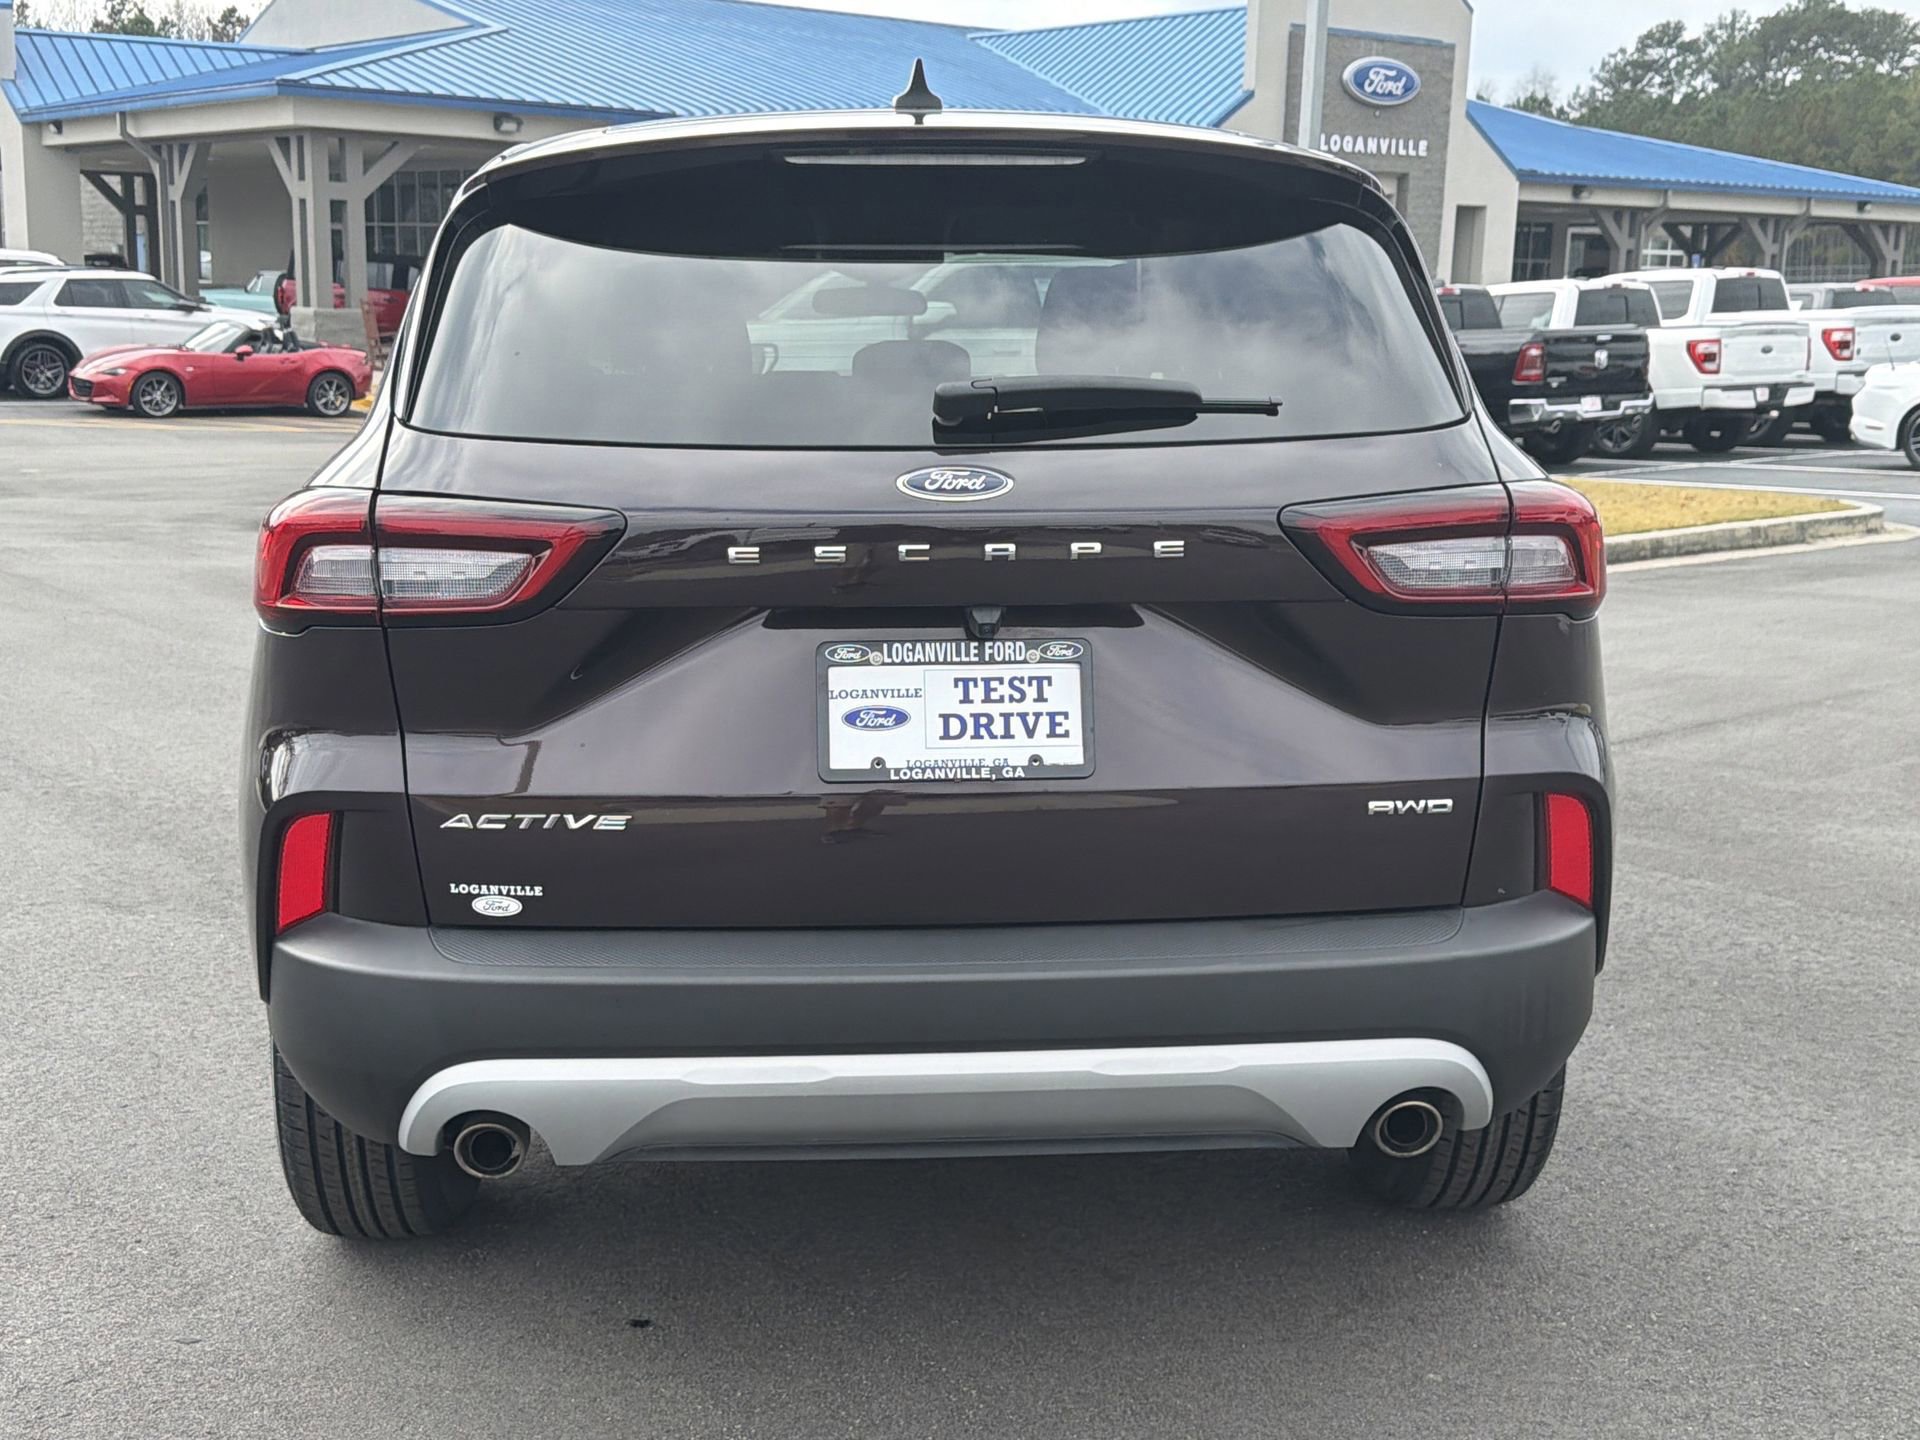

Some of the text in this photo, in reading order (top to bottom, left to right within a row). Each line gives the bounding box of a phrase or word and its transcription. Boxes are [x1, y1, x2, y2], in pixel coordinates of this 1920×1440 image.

[1364, 67, 1406, 95] Ford
[1320, 133, 1428, 156] LOGANVILLE
[925, 471, 986, 491] Ford
[727, 541, 1185, 564] ESCAPE
[834, 648, 862, 659] Ford
[883, 641, 1026, 663] LOGANVILLE FORD
[1046, 644, 1074, 656] Ford
[829, 688, 922, 700] LOGANVILLE
[953, 675, 1053, 704] TEST
[856, 709, 896, 727] Ford
[938, 711, 1070, 741] DRIVE
[890, 767, 1025, 780] LOGANVILLE, GA
[1368, 799, 1453, 815] AWD
[440, 813, 632, 830] ACTIVE
[450, 883, 543, 896] LOGANVILLE
[482, 900, 511, 912] Ford
